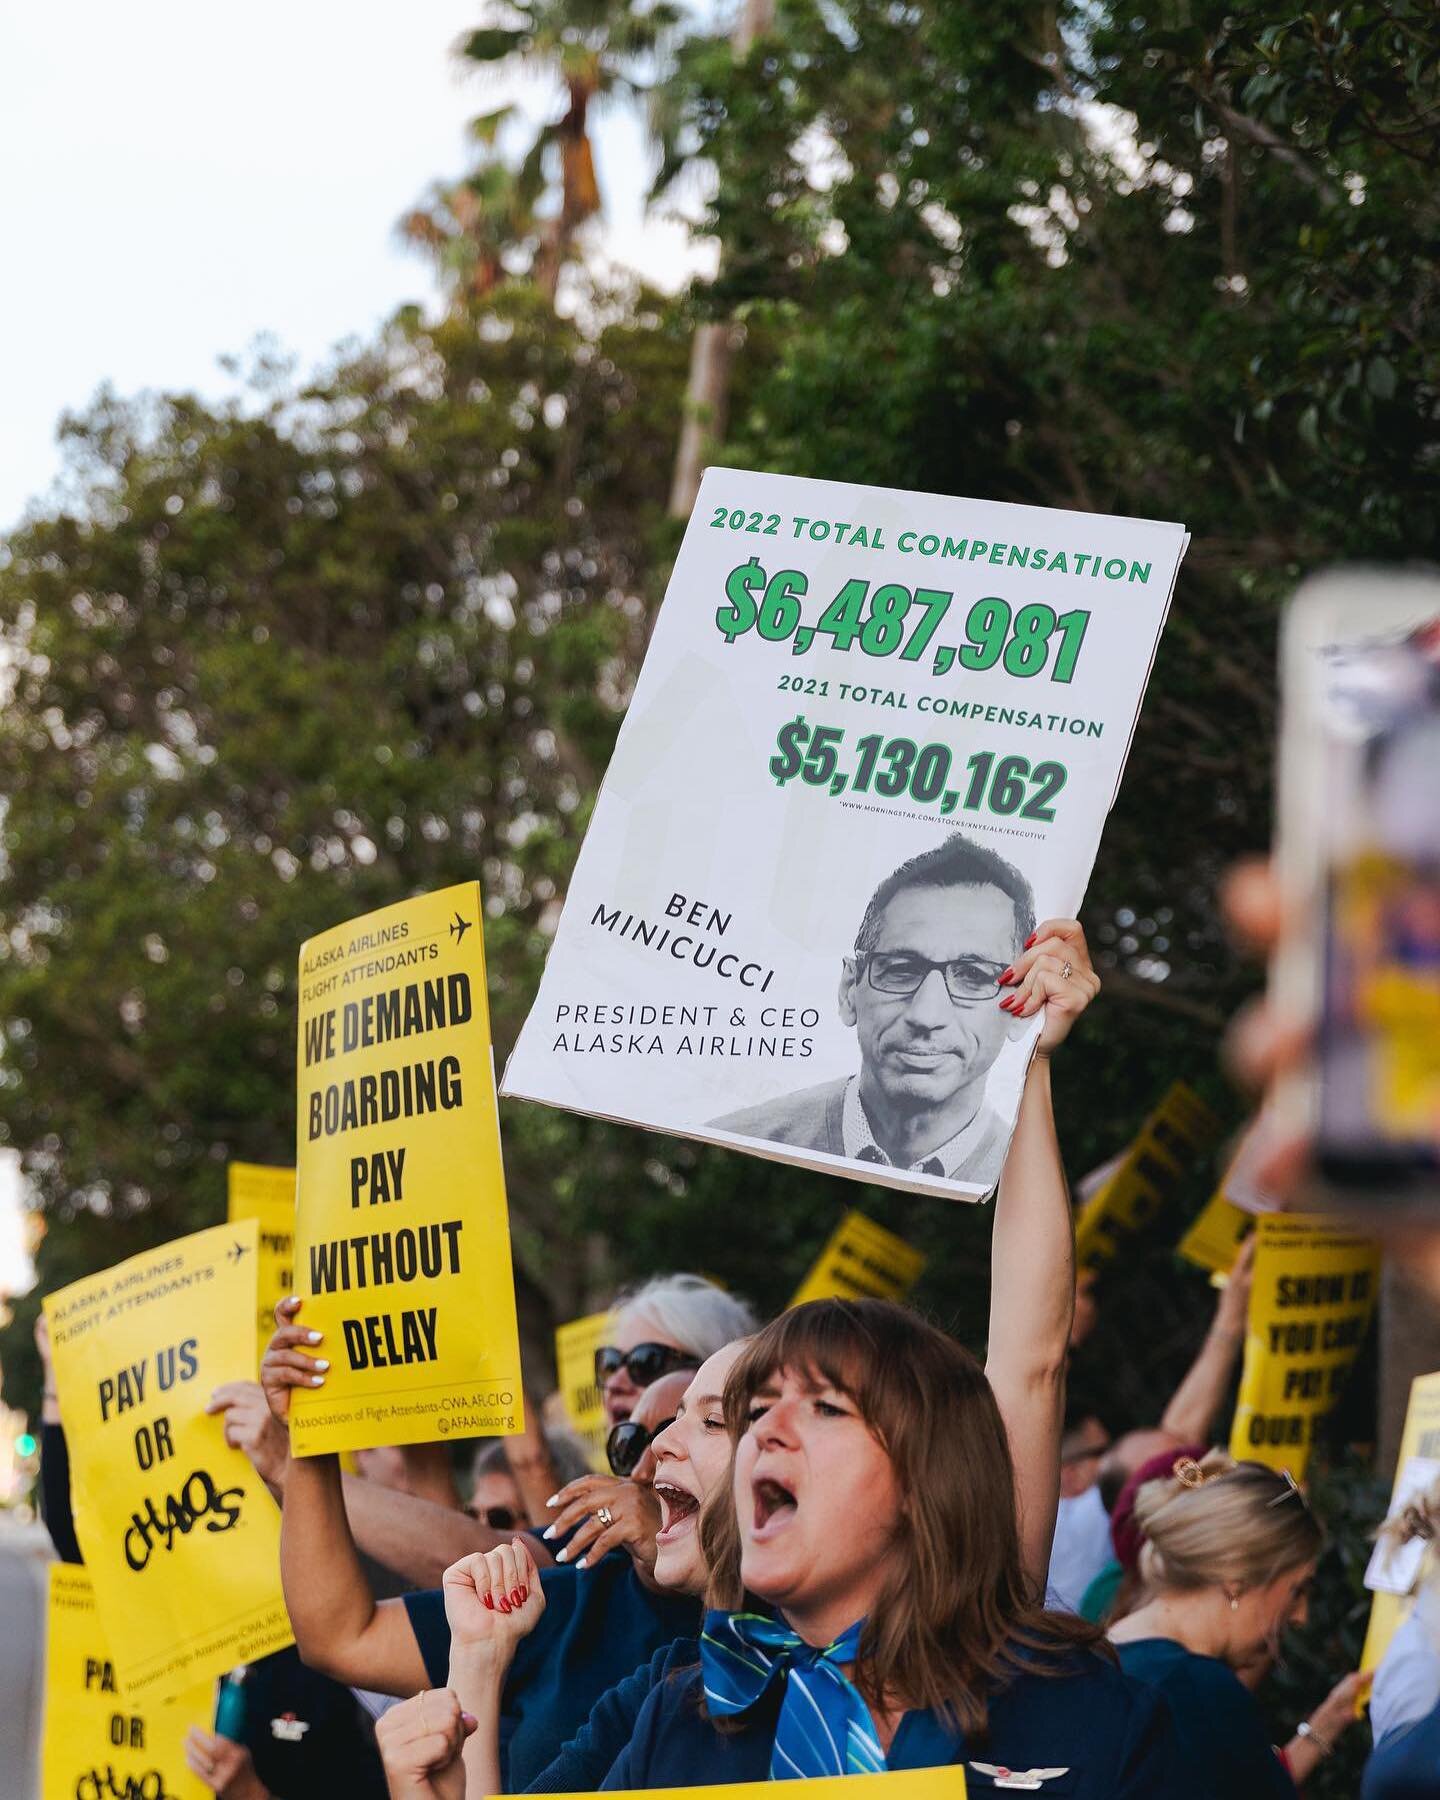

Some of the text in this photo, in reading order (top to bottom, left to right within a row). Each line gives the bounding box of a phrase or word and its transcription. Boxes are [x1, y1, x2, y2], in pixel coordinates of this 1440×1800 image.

[710, 507, 1153, 584] 2022 TOTAL COMPENSATION
[715, 556, 1092, 684] $6,487,981
[777, 674, 1105, 739] 2021 TOTAL COMPENSATION
[769, 715, 1068, 823] $5,130,162
[663, 892, 733, 938] BEN
[302, 921, 409, 977] ALASKA AIRLINES
[302, 943, 439, 1004] FLIGHT ATTENDANTS
[590, 903, 774, 994] MINICUCCI
[304, 971, 472, 1069] WE DEMAND
[552, 1032, 814, 1059] ALASKA AIRLINES
[556, 1004, 820, 1029] PRESIDENT & CEO
[308, 1054, 463, 1142] BOARDING
[350, 1147, 406, 1209] PAY
[112, 1256, 184, 1294] AIRLINES
[309, 1219, 463, 1296] WITHOUT
[106, 1267, 215, 1320] ATTENDANTS
[342, 1306, 438, 1371] DELAY
[98, 1337, 199, 1423] PAY US
[134, 1416, 175, 1472] OR
[293, 1412, 353, 1429] Association
[354, 1409, 364, 1421] of
[366, 1404, 389, 1421] Flight
[123, 1470, 246, 1572] CHAOS
[83, 1656, 118, 1692] PA
[110, 1713, 145, 1749] OR
